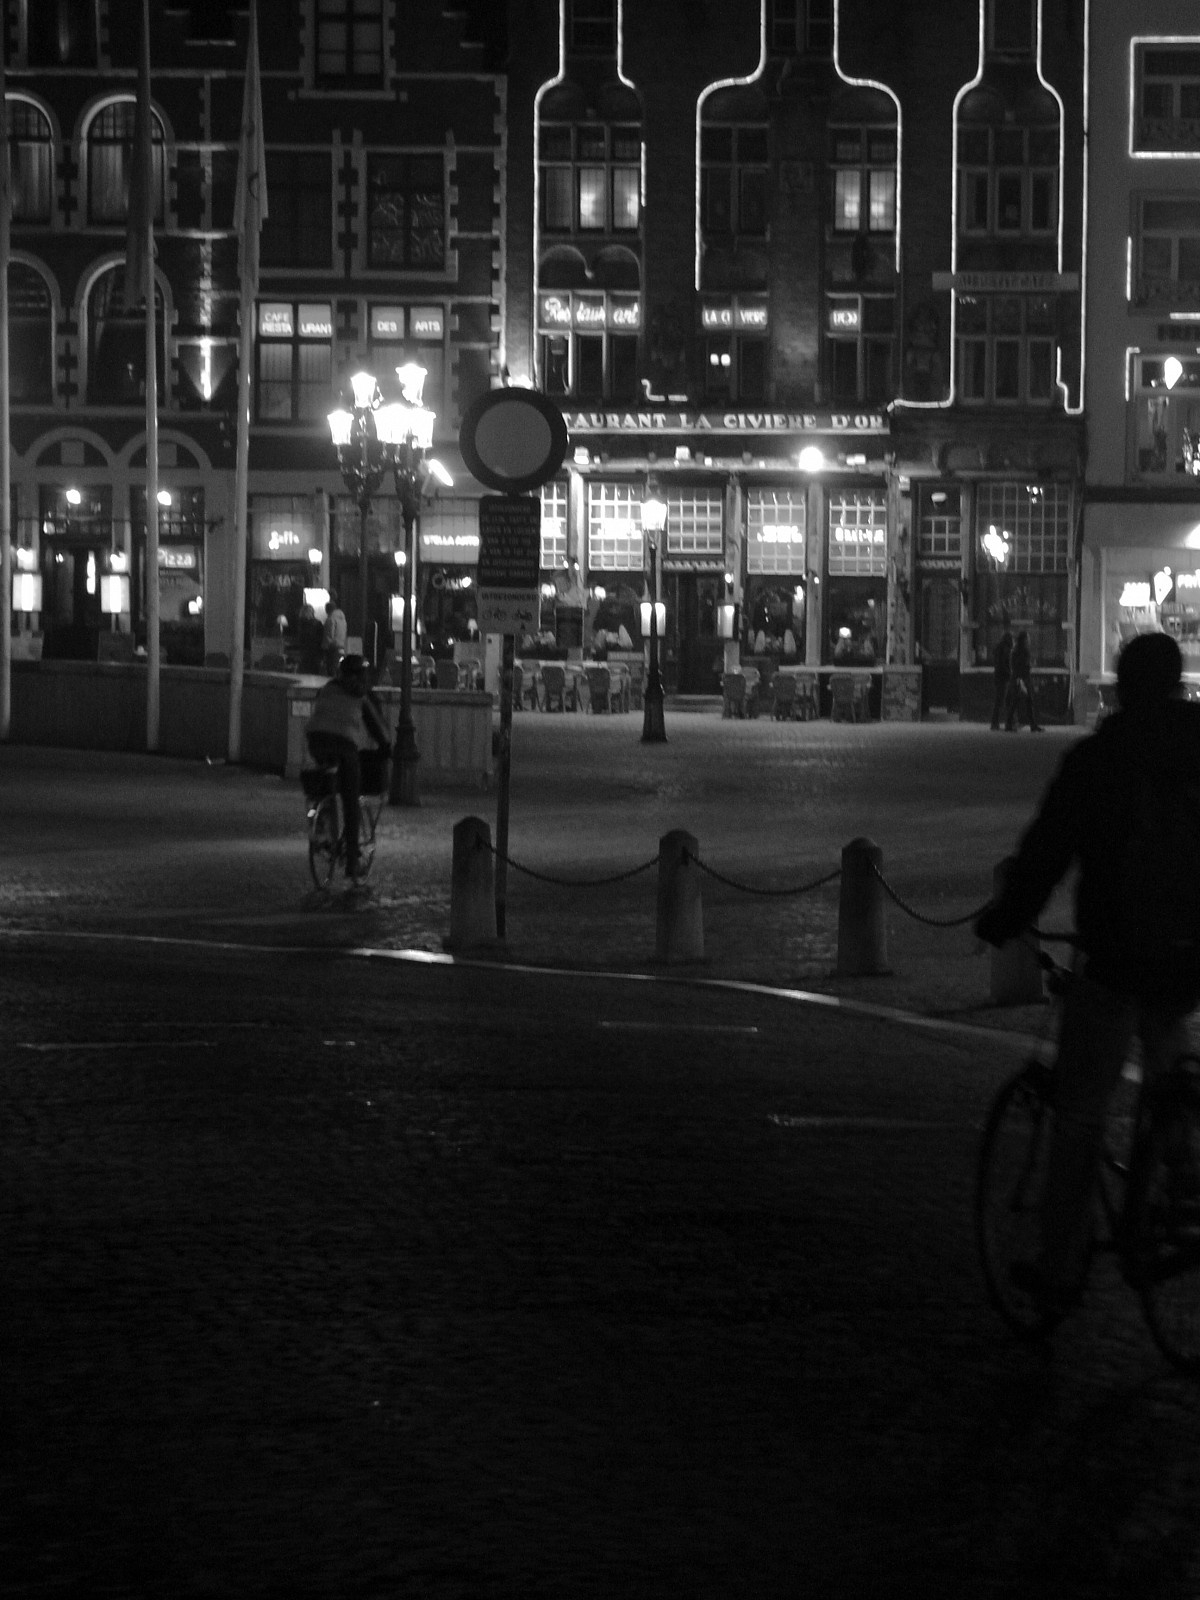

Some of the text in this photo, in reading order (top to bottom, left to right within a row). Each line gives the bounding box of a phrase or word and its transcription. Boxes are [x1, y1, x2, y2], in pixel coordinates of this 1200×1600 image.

[377, 320, 397, 332] DES
[415, 320, 441, 333] ARTS
[561, 412, 666, 429] TAURANT
[679, 412, 712, 429] LA
[831, 414, 884, 430] D'OR
[422, 534, 480, 547] STELLA ARTO
